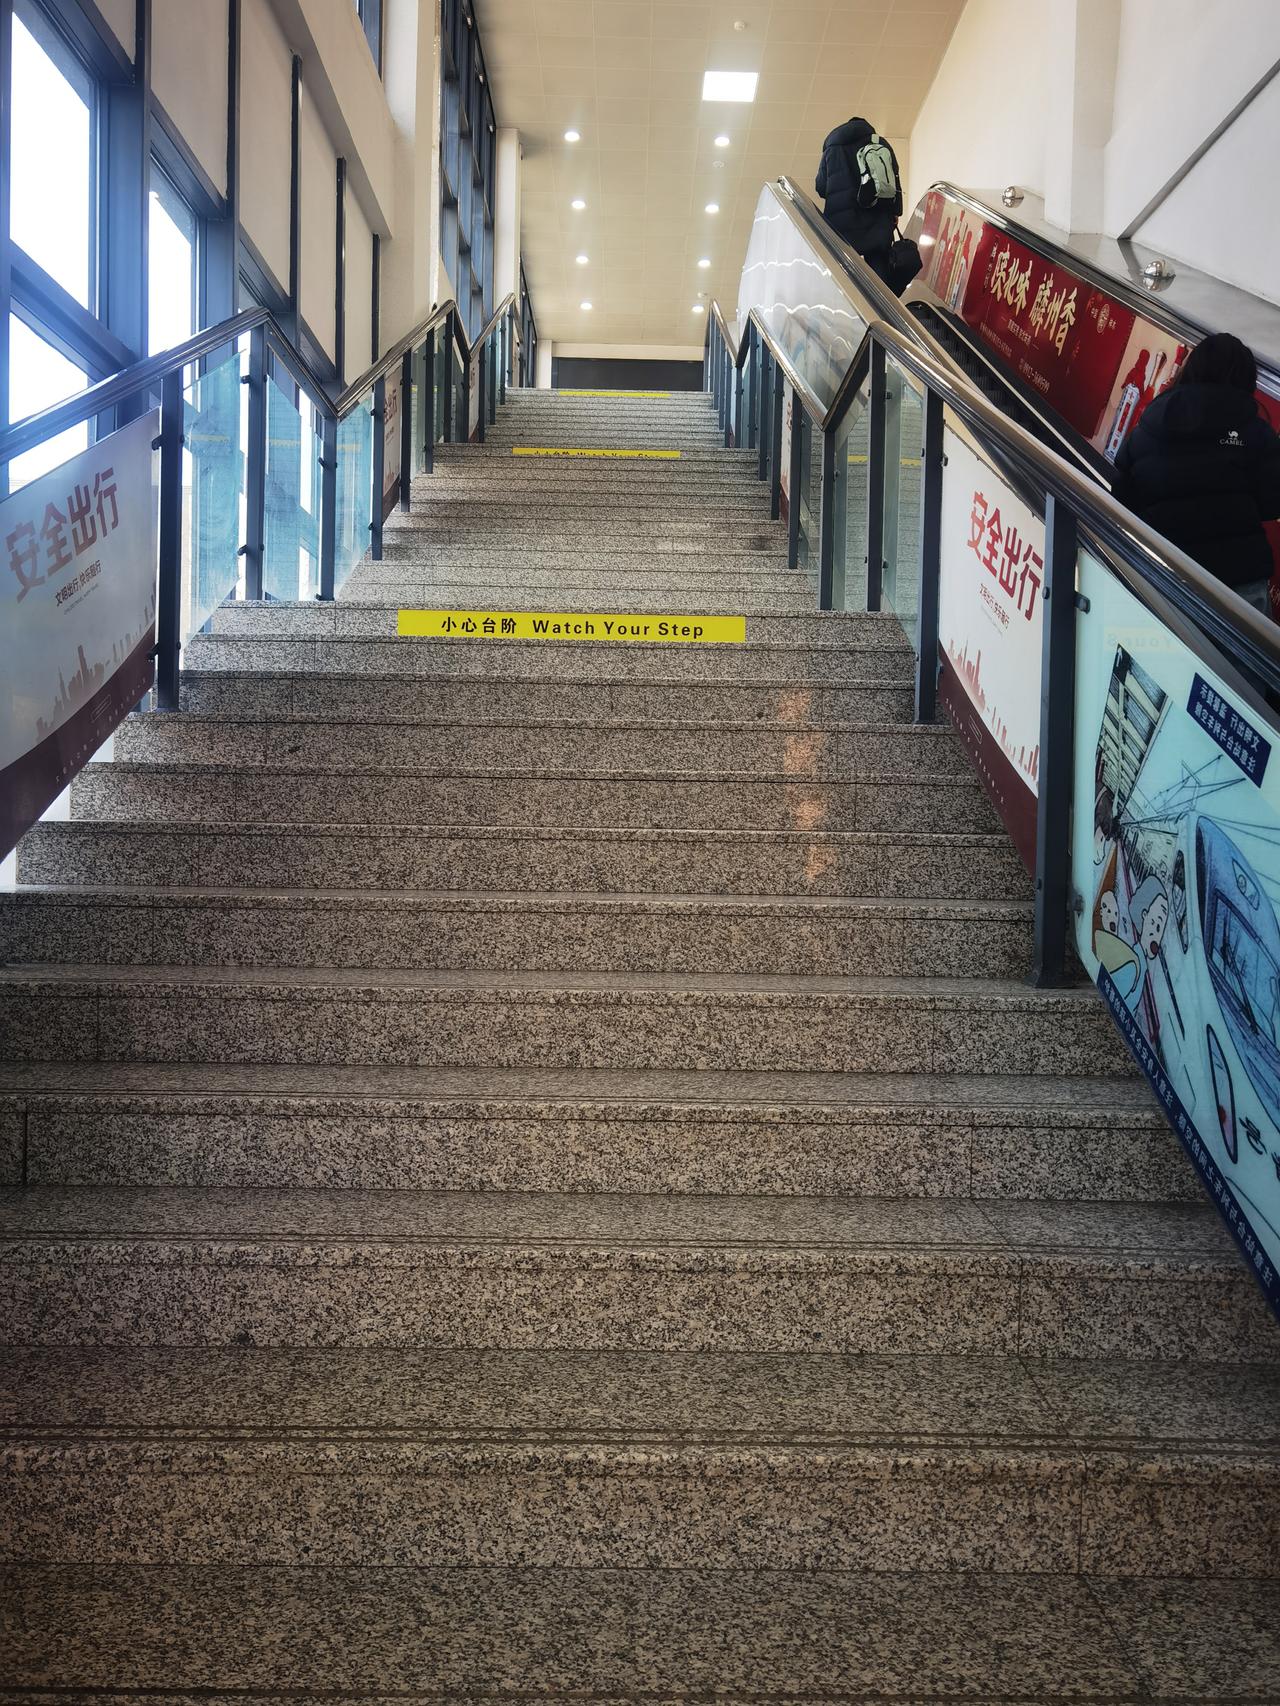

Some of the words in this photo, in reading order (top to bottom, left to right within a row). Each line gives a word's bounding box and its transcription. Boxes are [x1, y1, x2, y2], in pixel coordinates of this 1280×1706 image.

[1219, 438, 1245, 447] CAMEL
[5, 466, 119, 603] 安全出行
[967, 491, 1044, 622] 安全出行
[441, 616, 518, 634] 小心台阶
[532, 619, 595, 635] Watch
[603, 621, 650, 635] Your
[658, 622, 704, 639] Step
